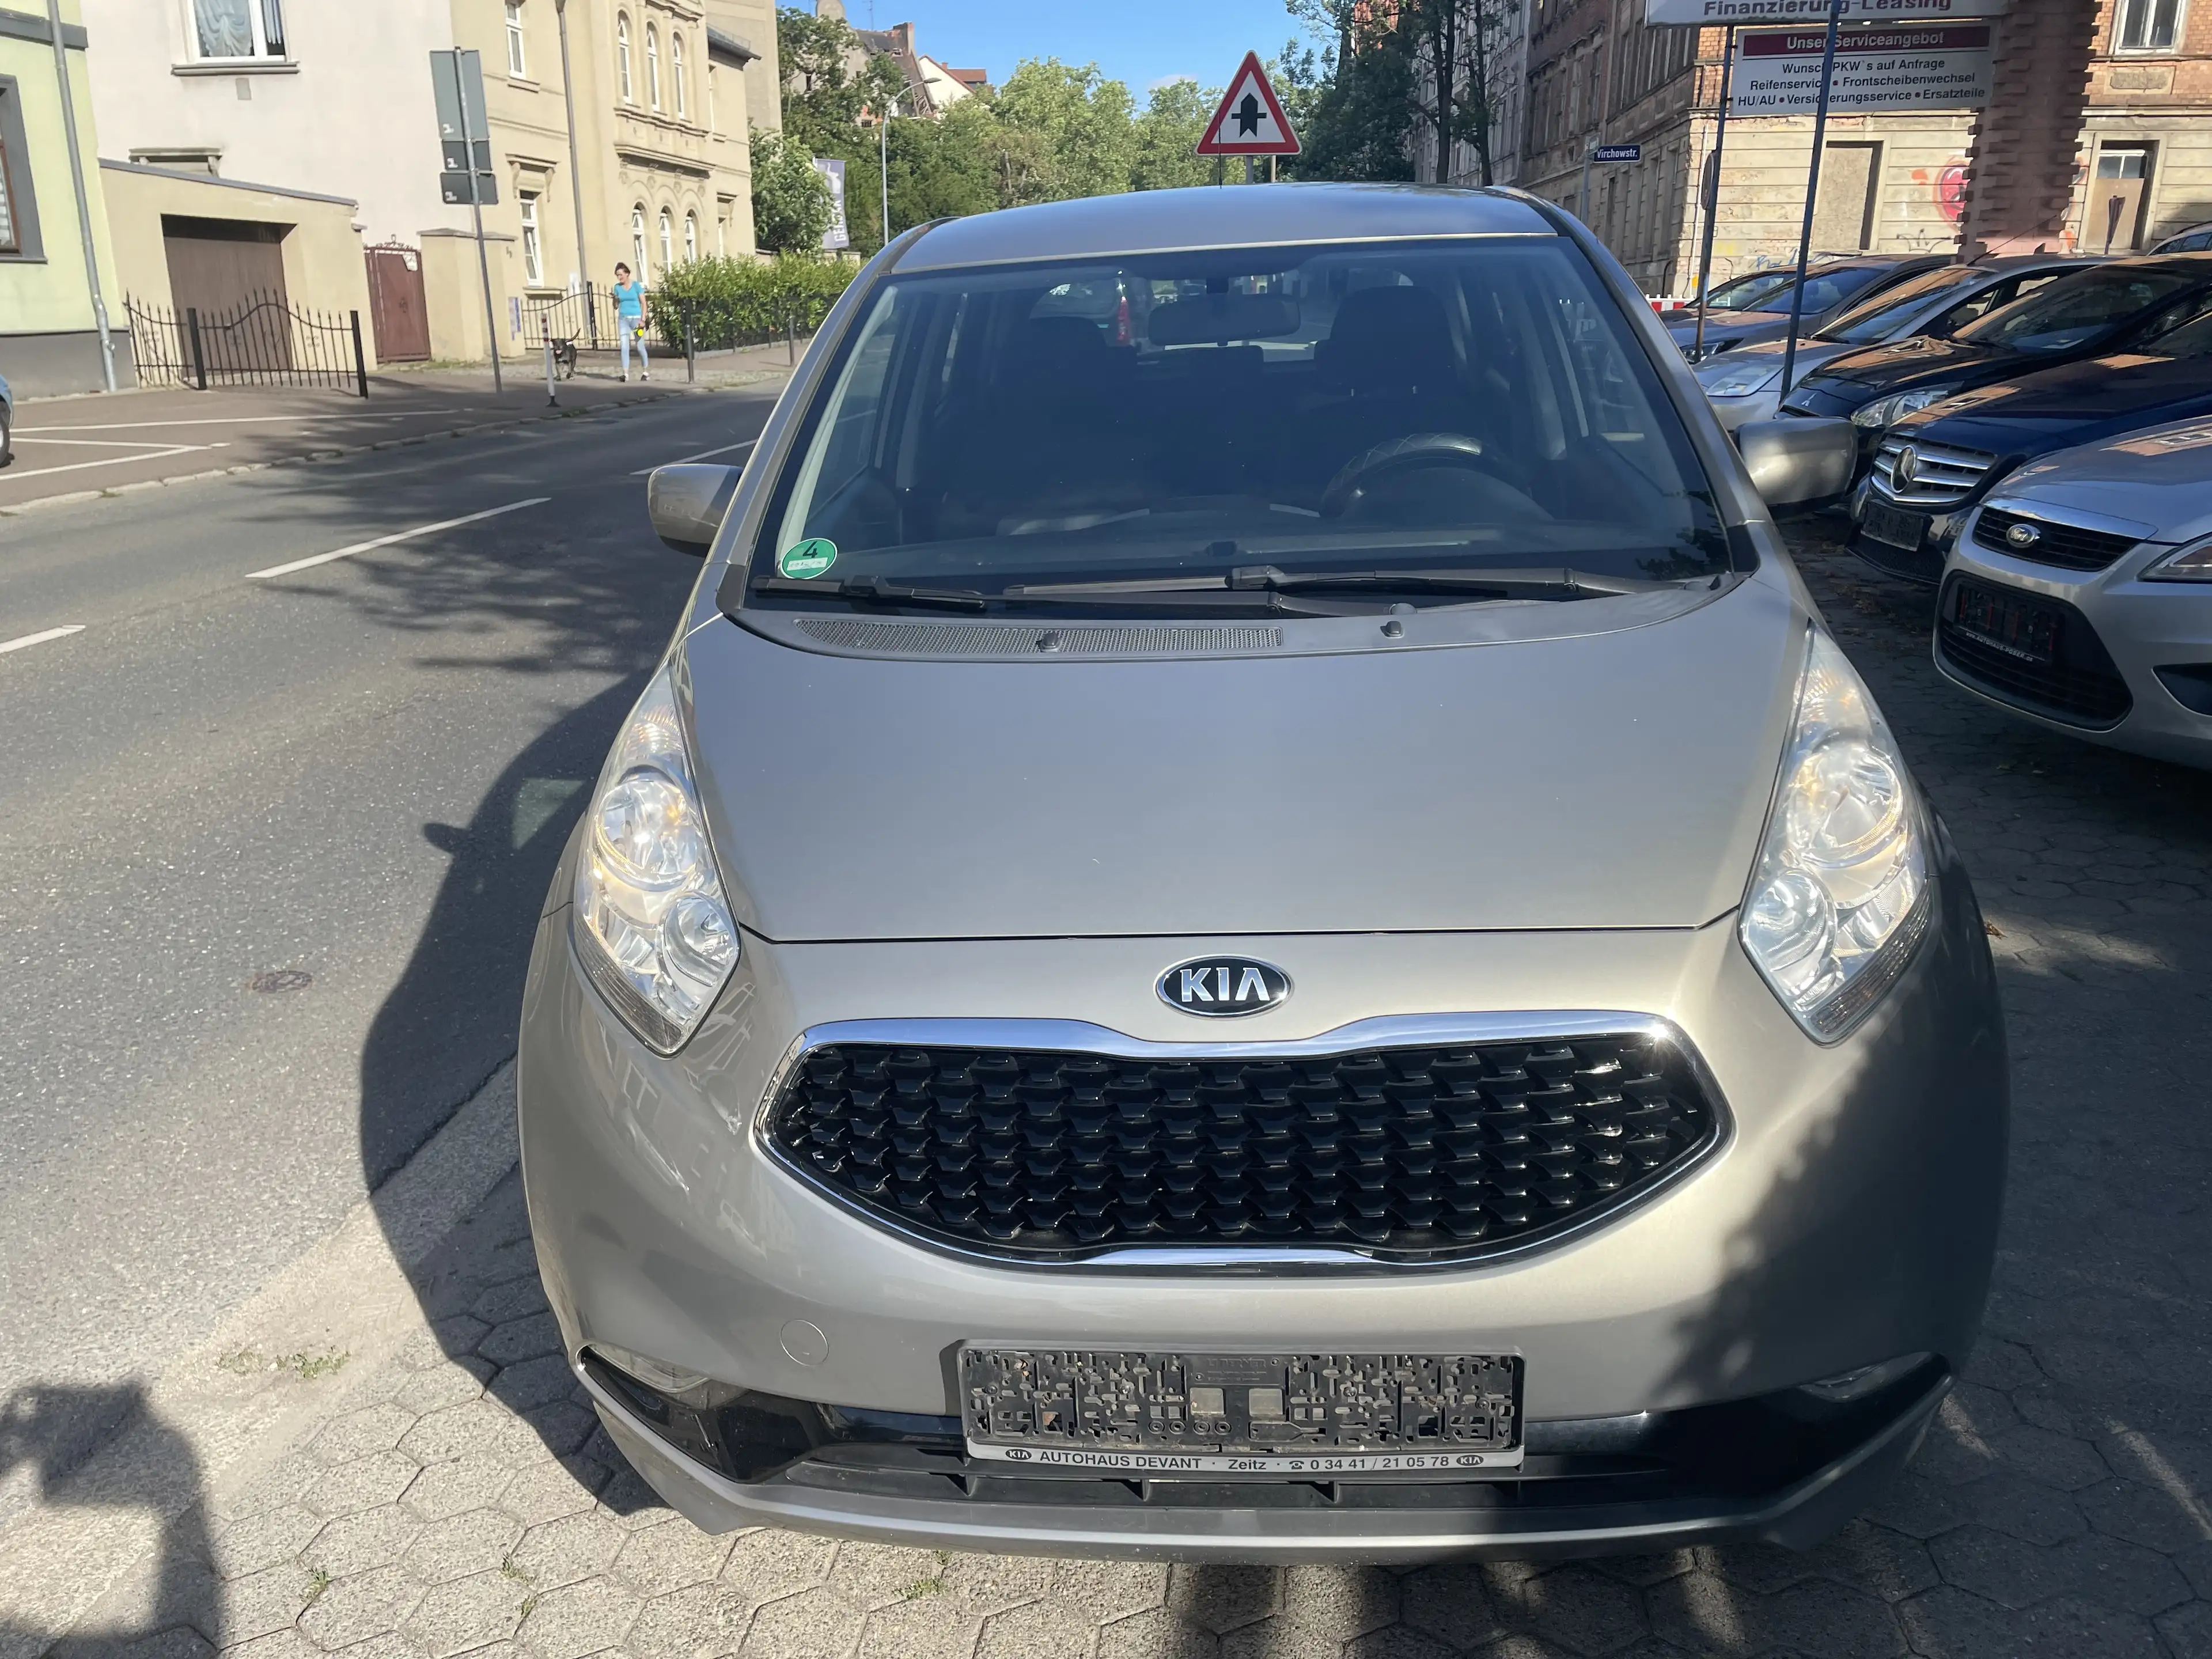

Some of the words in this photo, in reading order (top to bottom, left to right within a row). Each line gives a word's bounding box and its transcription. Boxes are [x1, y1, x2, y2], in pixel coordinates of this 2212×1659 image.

[1834, 32, 1944, 48] Serviceangebot
[1877, 60, 1895, 70] auf
[1898, 59, 1945, 71] Anfrage
[1750, 79, 1822, 90] Reifenservic
[1843, 73, 1975, 87] Frontscheibenwechsel
[1738, 94, 1776, 107] HU/AU
[1787, 90, 1912, 105] Versicerungsservice
[1923, 88, 1986, 100] Ersatzteile
[1597, 149, 1638, 158] Virchowstr.
[802, 541, 818, 558] 4
[1179, 967, 1271, 1003] KIA
[1007, 1449, 1031, 1459] KIA
[1040, 1450, 1130, 1467] AUTOHAUS
[1136, 1456, 1202, 1469] DEVANT
[1228, 1459, 1267, 1470] Zeitz
[1310, 1460, 1320, 1469] 0
[1325, 1459, 1343, 1469] 34
[1349, 1459, 1365, 1468] 41
[1382, 1457, 1399, 1467] 21
[1407, 1457, 1425, 1467] 05
[1430, 1456, 1449, 1467] 78
[1458, 1455, 1483, 1465] KIA
